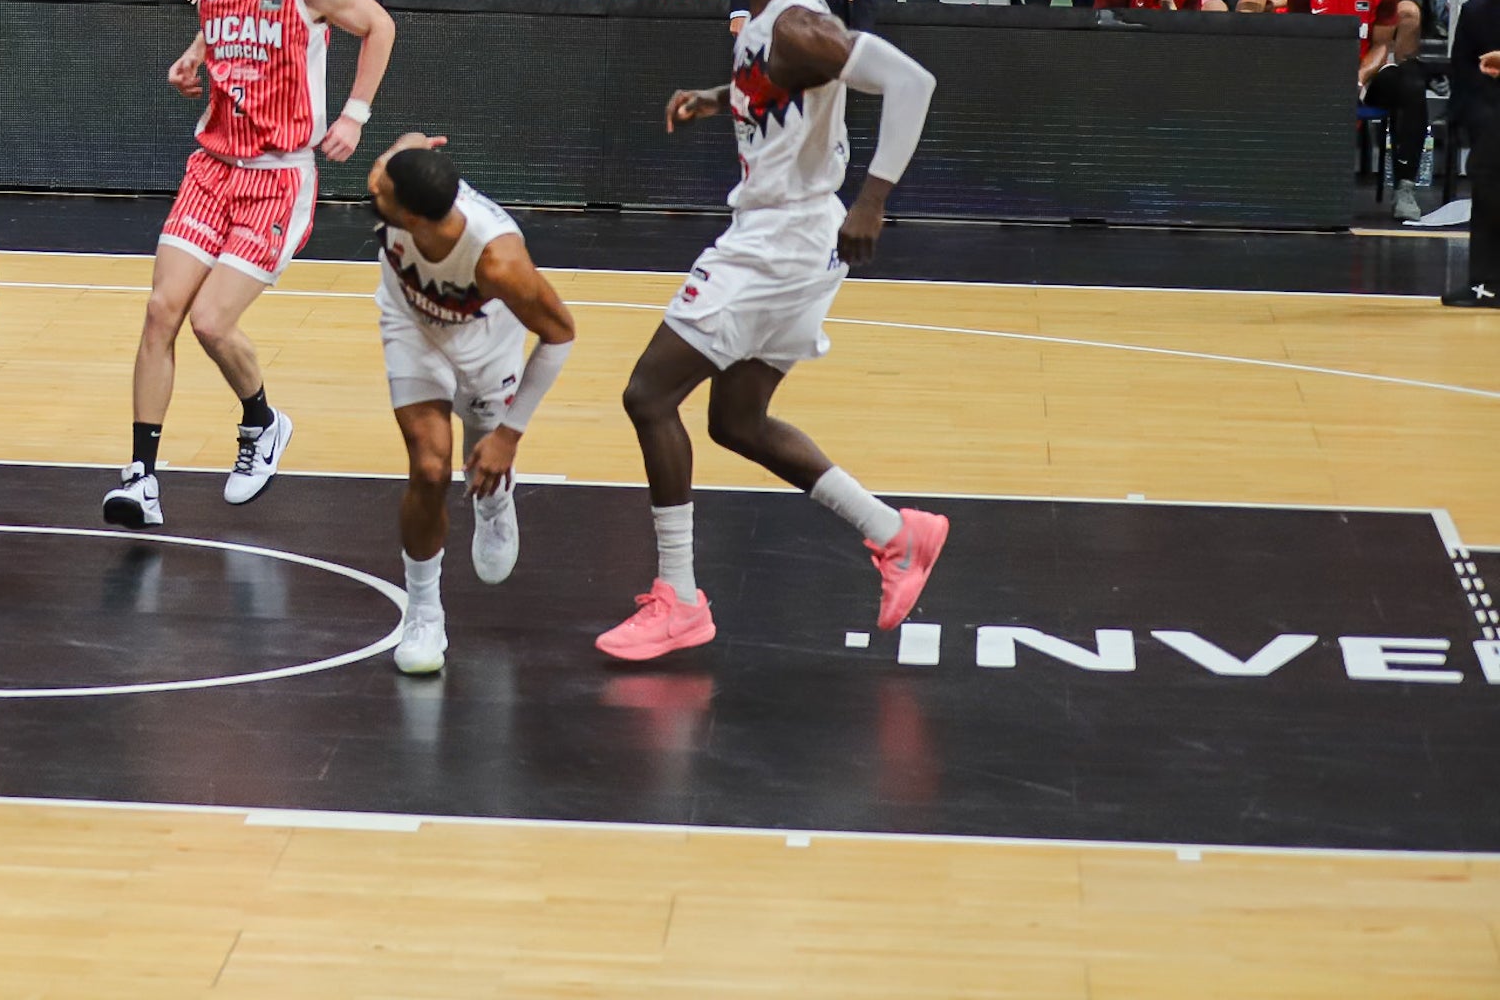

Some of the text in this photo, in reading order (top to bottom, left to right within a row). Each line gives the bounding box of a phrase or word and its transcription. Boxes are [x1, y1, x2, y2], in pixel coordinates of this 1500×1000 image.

[204, 16, 283, 50] UCAM
[213, 43, 269, 63] MURCIA
[232, 85, 246, 117] 2
[897, 622, 1500, 685] INVE
